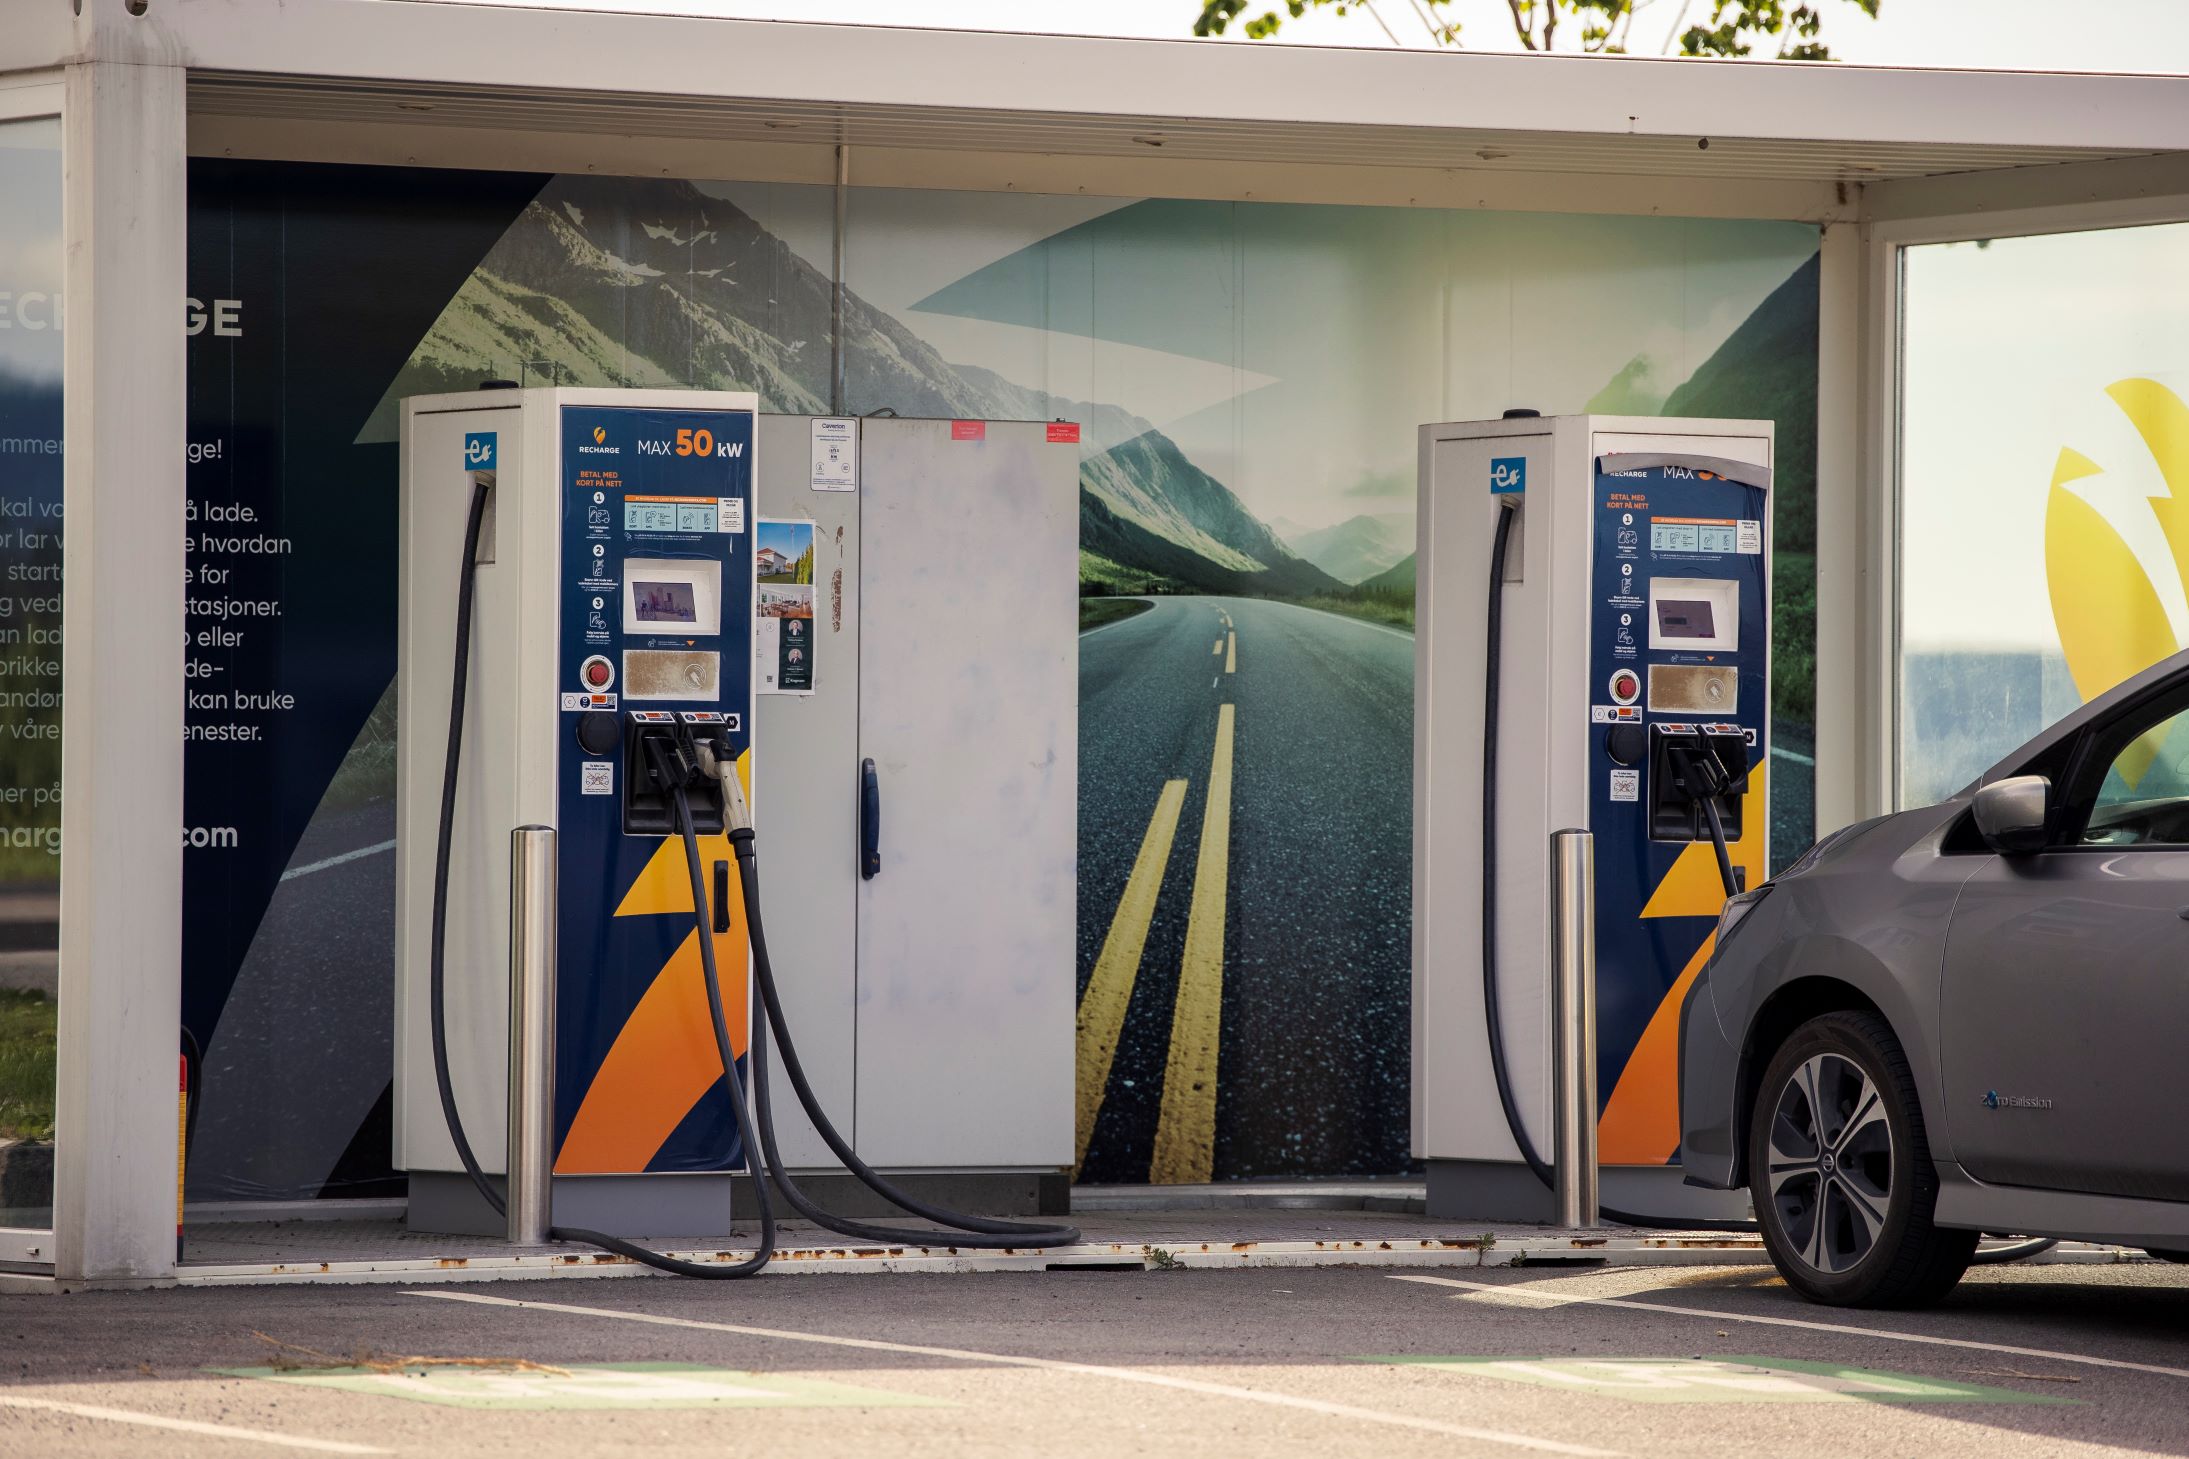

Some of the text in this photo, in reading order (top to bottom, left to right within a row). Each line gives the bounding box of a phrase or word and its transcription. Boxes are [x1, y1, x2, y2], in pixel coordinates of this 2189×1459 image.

[1, 437, 222, 463] mme ge!
[579, 446, 620, 454] RECHARGE
[637, 429, 743, 458] MAX 50 kW
[1663, 466, 1695, 480] MAX
[205, 500, 259, 522] lade.
[20, 528, 48, 549] lar
[202, 532, 292, 554] hvordan
[8, 562, 64, 581] start
[200, 563, 230, 584] for
[20, 593, 61, 613] ved
[197, 626, 244, 647] eller
[189, 689, 228, 710] kan
[234, 690, 295, 711] bruke
[10, 717, 60, 739] våre
[0, 787, 27, 803] er
